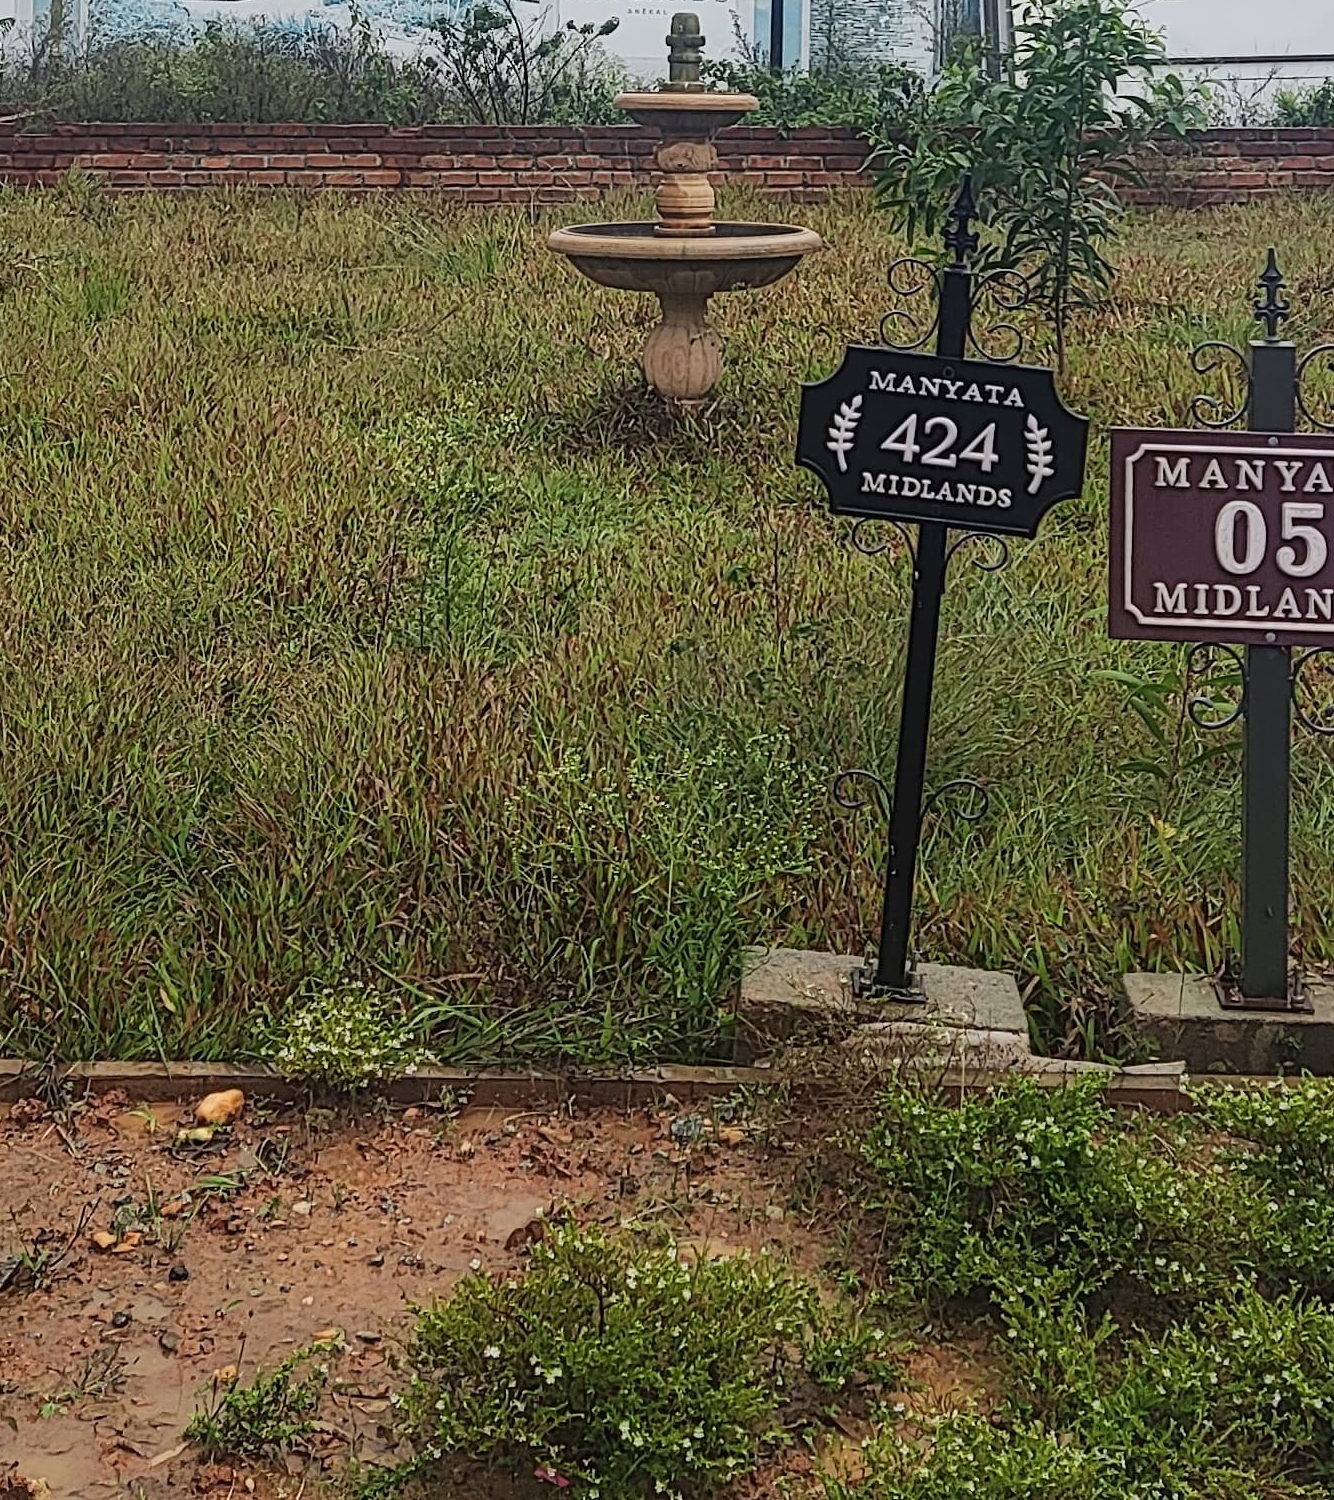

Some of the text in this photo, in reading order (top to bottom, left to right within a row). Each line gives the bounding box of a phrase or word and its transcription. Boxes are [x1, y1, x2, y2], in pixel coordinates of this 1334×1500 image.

[868, 371, 1025, 408] MANYATA
[880, 412, 999, 473] 424
[861, 472, 1012, 509] MIDLANDS
[1214, 500, 1328, 578] 05
